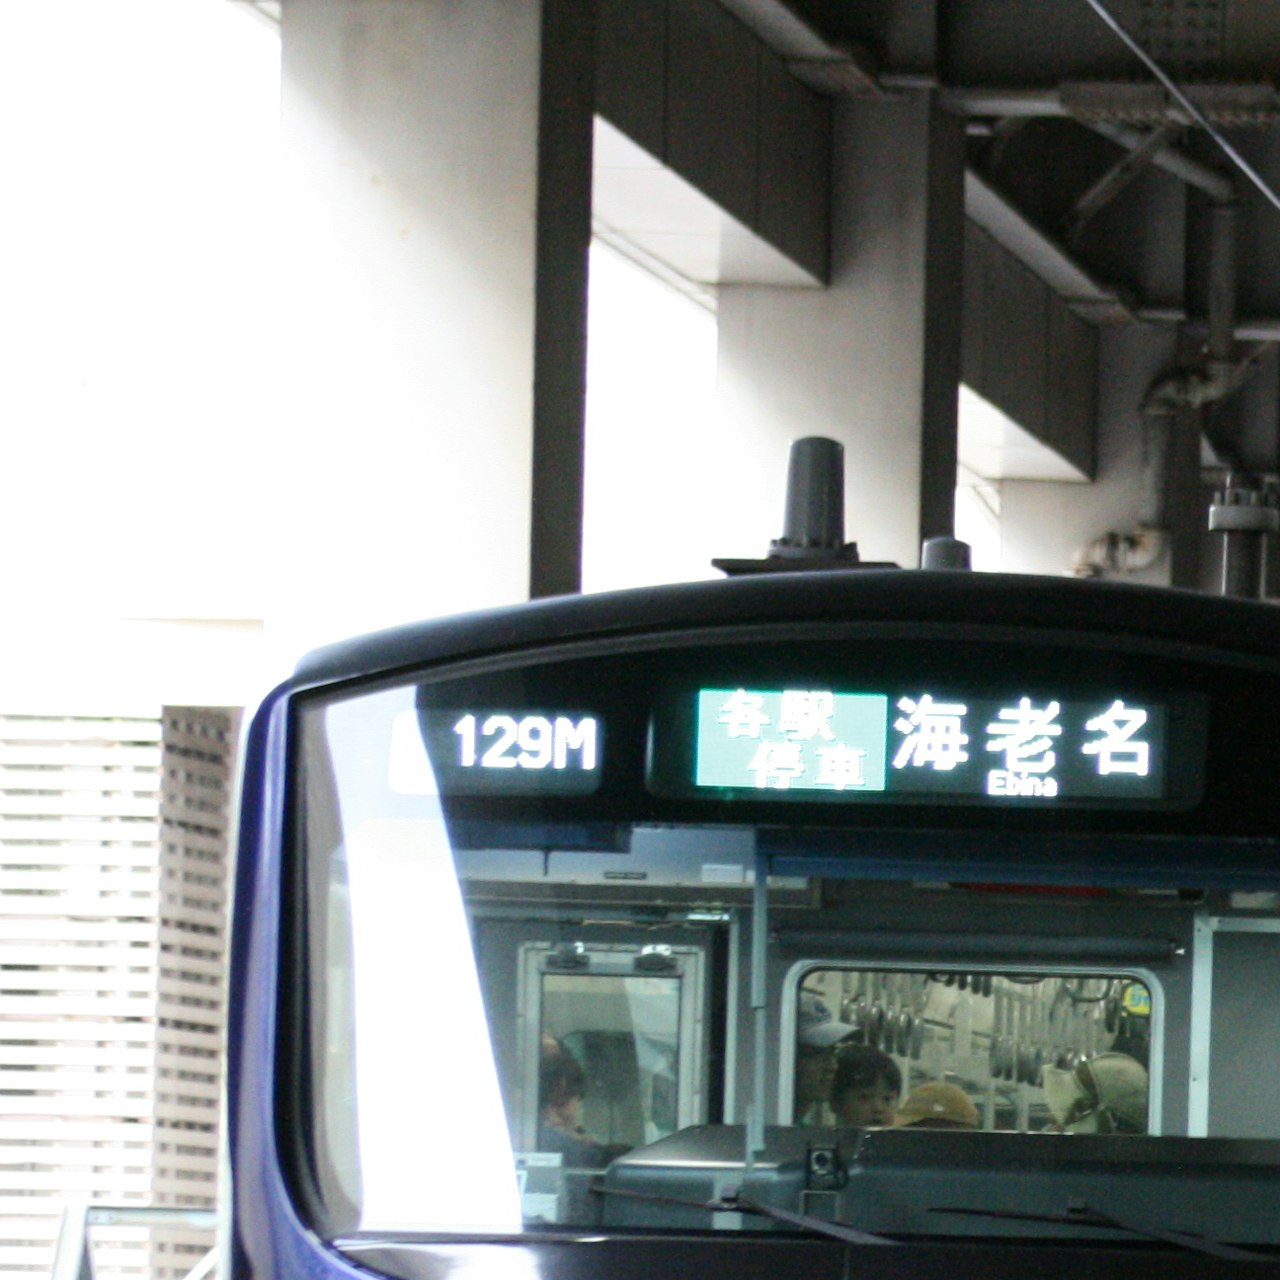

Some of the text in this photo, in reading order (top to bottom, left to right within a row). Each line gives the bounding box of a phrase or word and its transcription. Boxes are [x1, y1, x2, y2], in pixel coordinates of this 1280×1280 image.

[453, 712, 597, 770] 129M
[718, 689, 835, 741] 各駅
[891, 694, 1150, 776] 海老名
[746, 740, 867, 790] 停車
[986, 768, 1058, 797] Ebina
